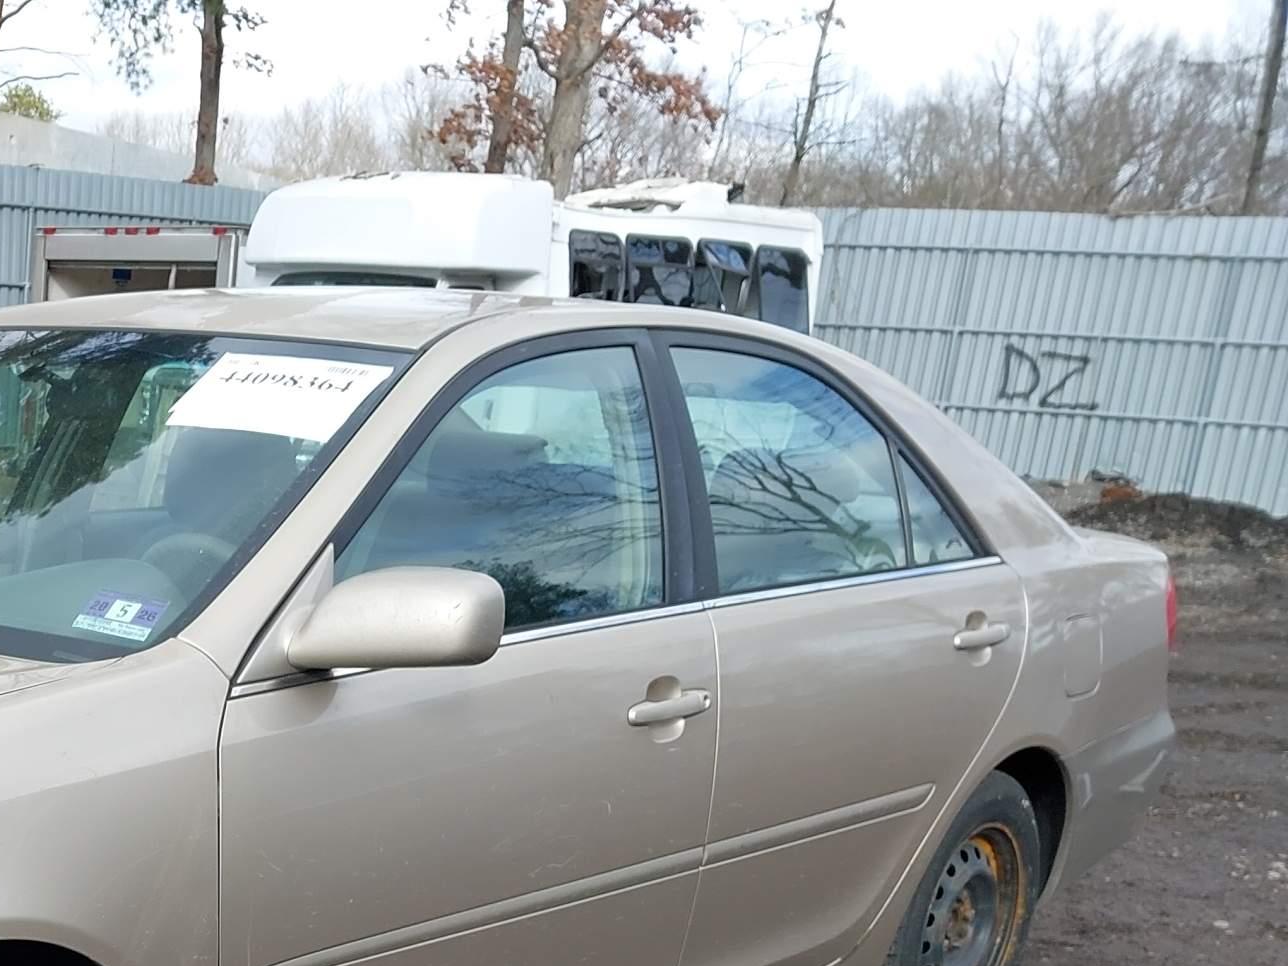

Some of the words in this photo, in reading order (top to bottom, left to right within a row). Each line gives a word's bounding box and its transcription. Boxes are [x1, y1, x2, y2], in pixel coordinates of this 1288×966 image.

[221, 371, 353, 392] 44098364
[999, 344, 1099, 411] DZ
[90, 600, 109, 612] 20
[117, 604, 132, 618] 5
[136, 609, 158, 622] 26
